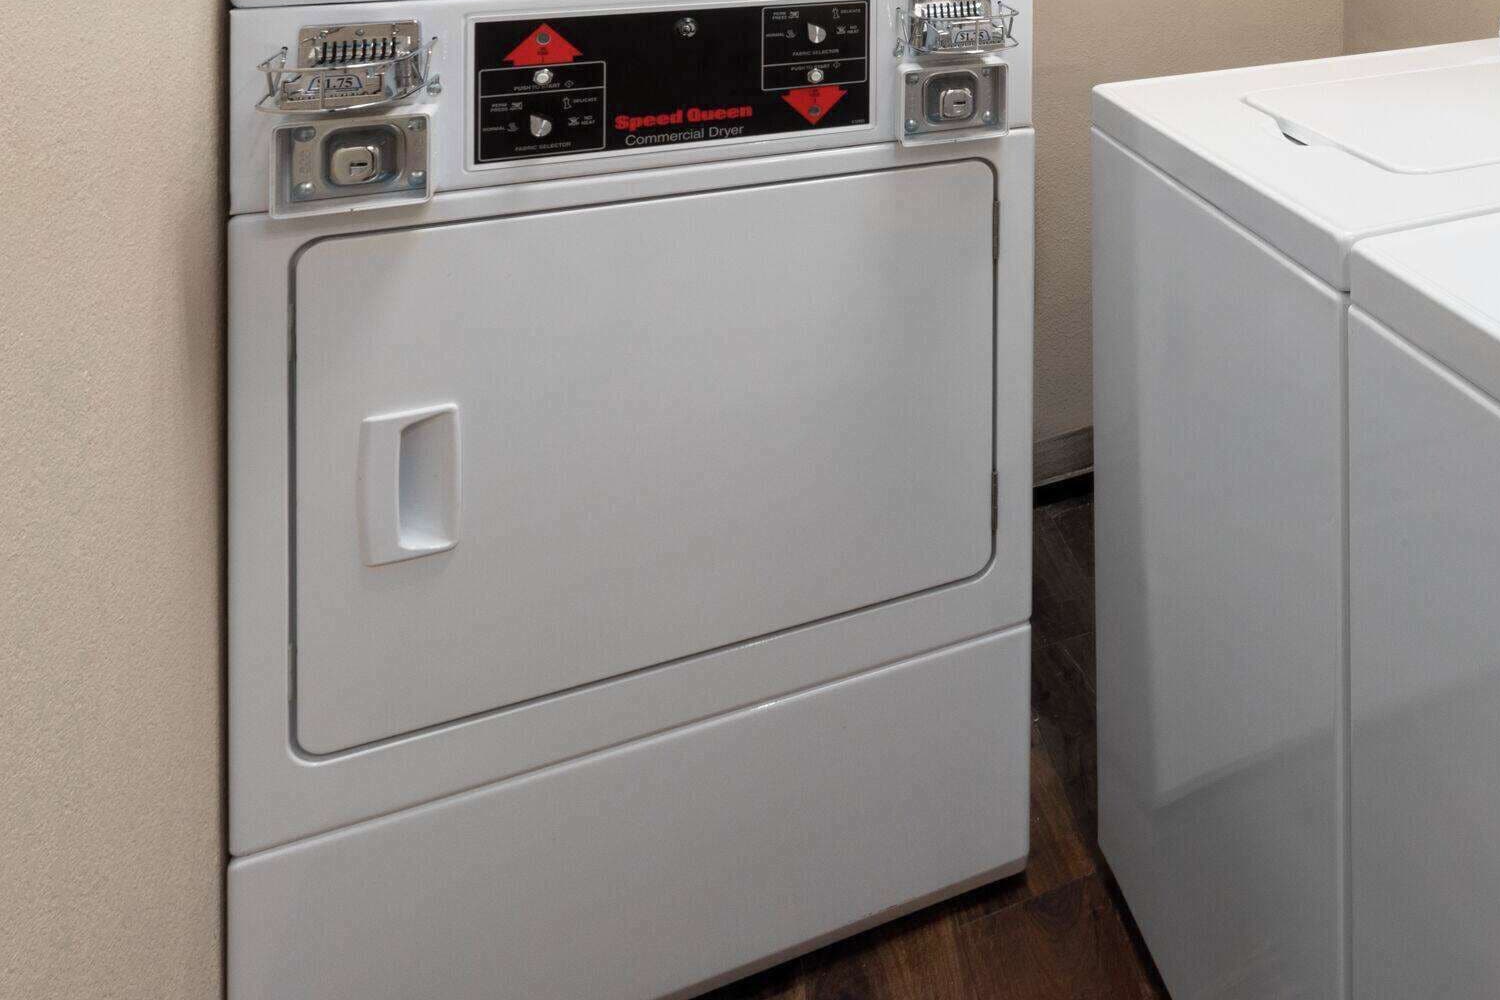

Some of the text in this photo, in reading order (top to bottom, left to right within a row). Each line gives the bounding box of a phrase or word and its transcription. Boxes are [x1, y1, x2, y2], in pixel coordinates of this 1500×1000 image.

[615, 105, 753, 131] Speed Queen
[625, 125, 744, 146] Commercial Dryer
